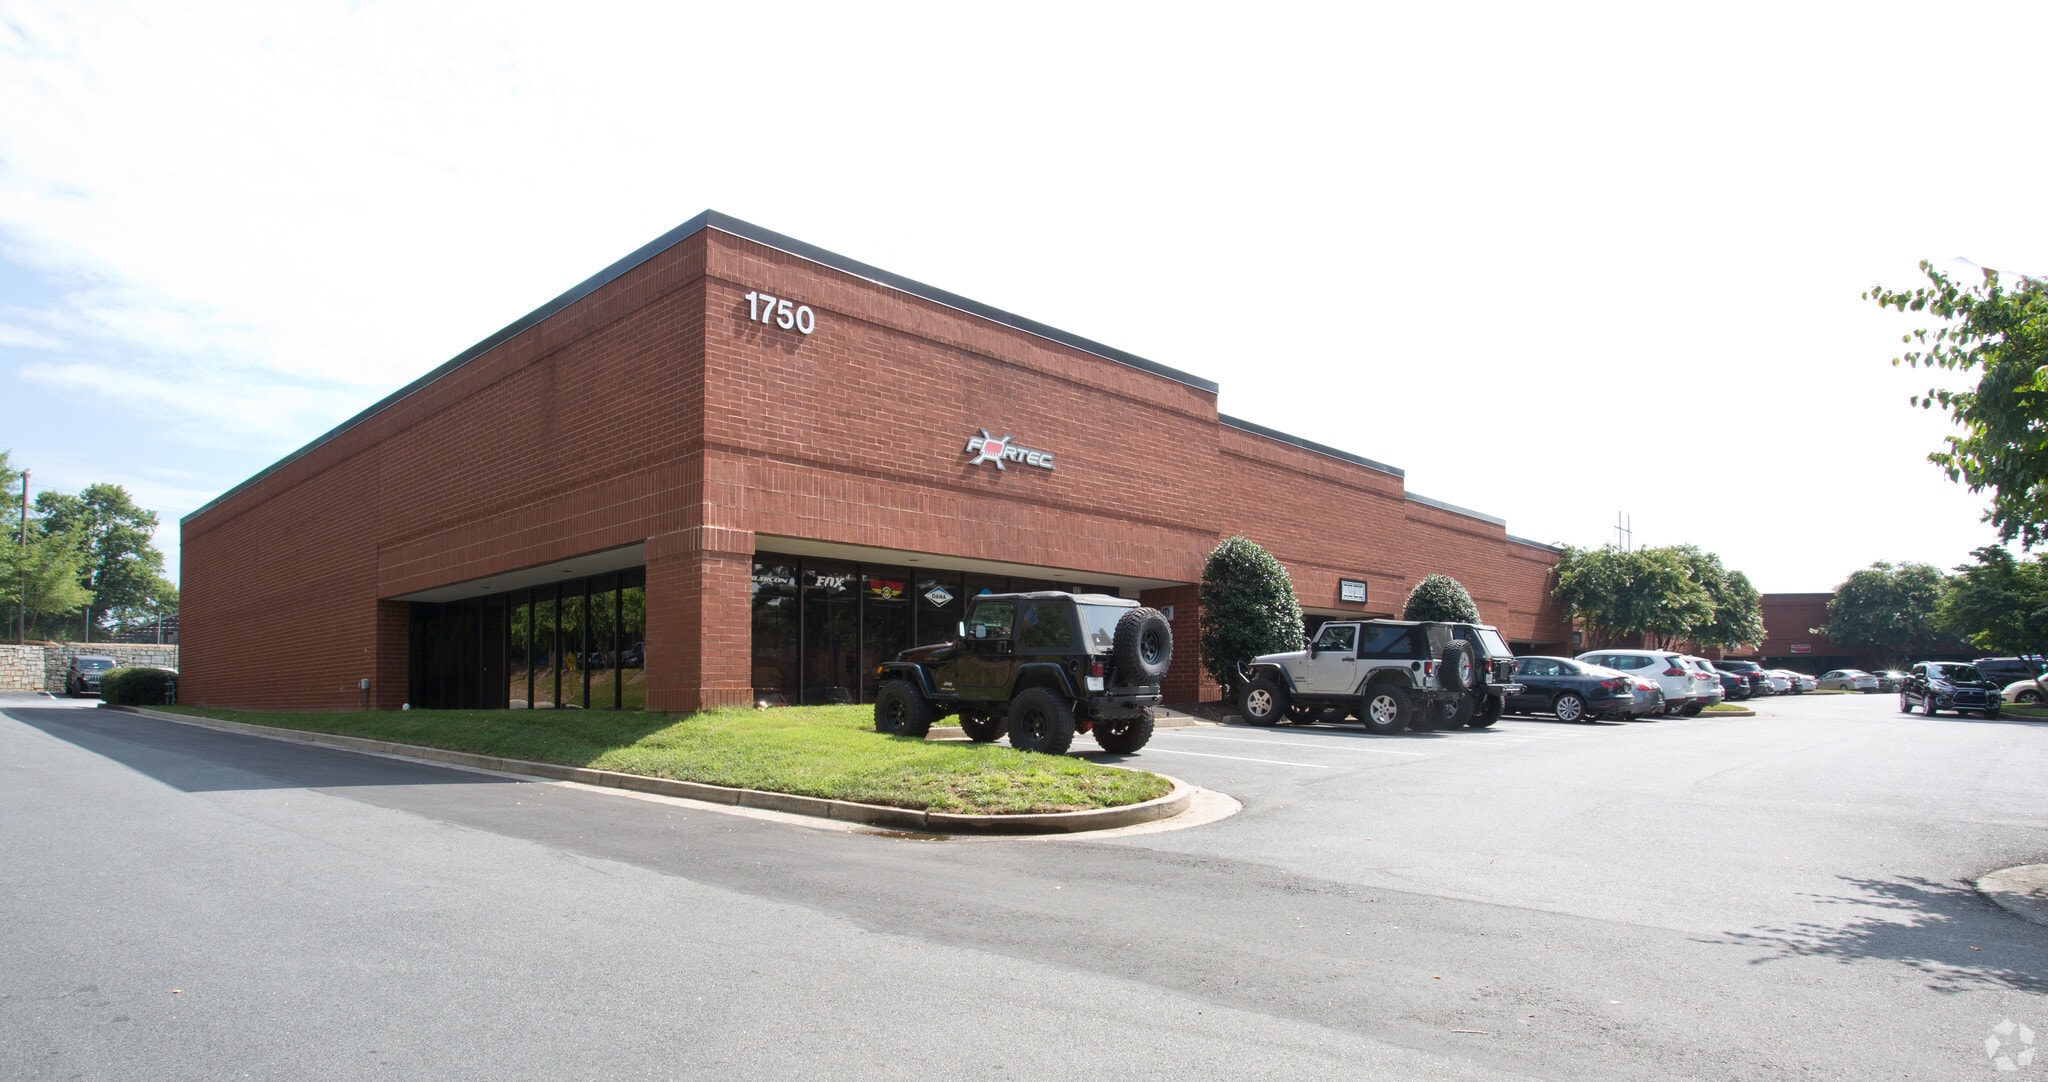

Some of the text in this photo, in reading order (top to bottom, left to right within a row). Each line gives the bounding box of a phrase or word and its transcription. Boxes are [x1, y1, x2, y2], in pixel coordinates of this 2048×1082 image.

[745, 291, 815, 335] 1750
[965, 433, 1056, 470] FORTEC
[815, 575, 847, 591] FOX
